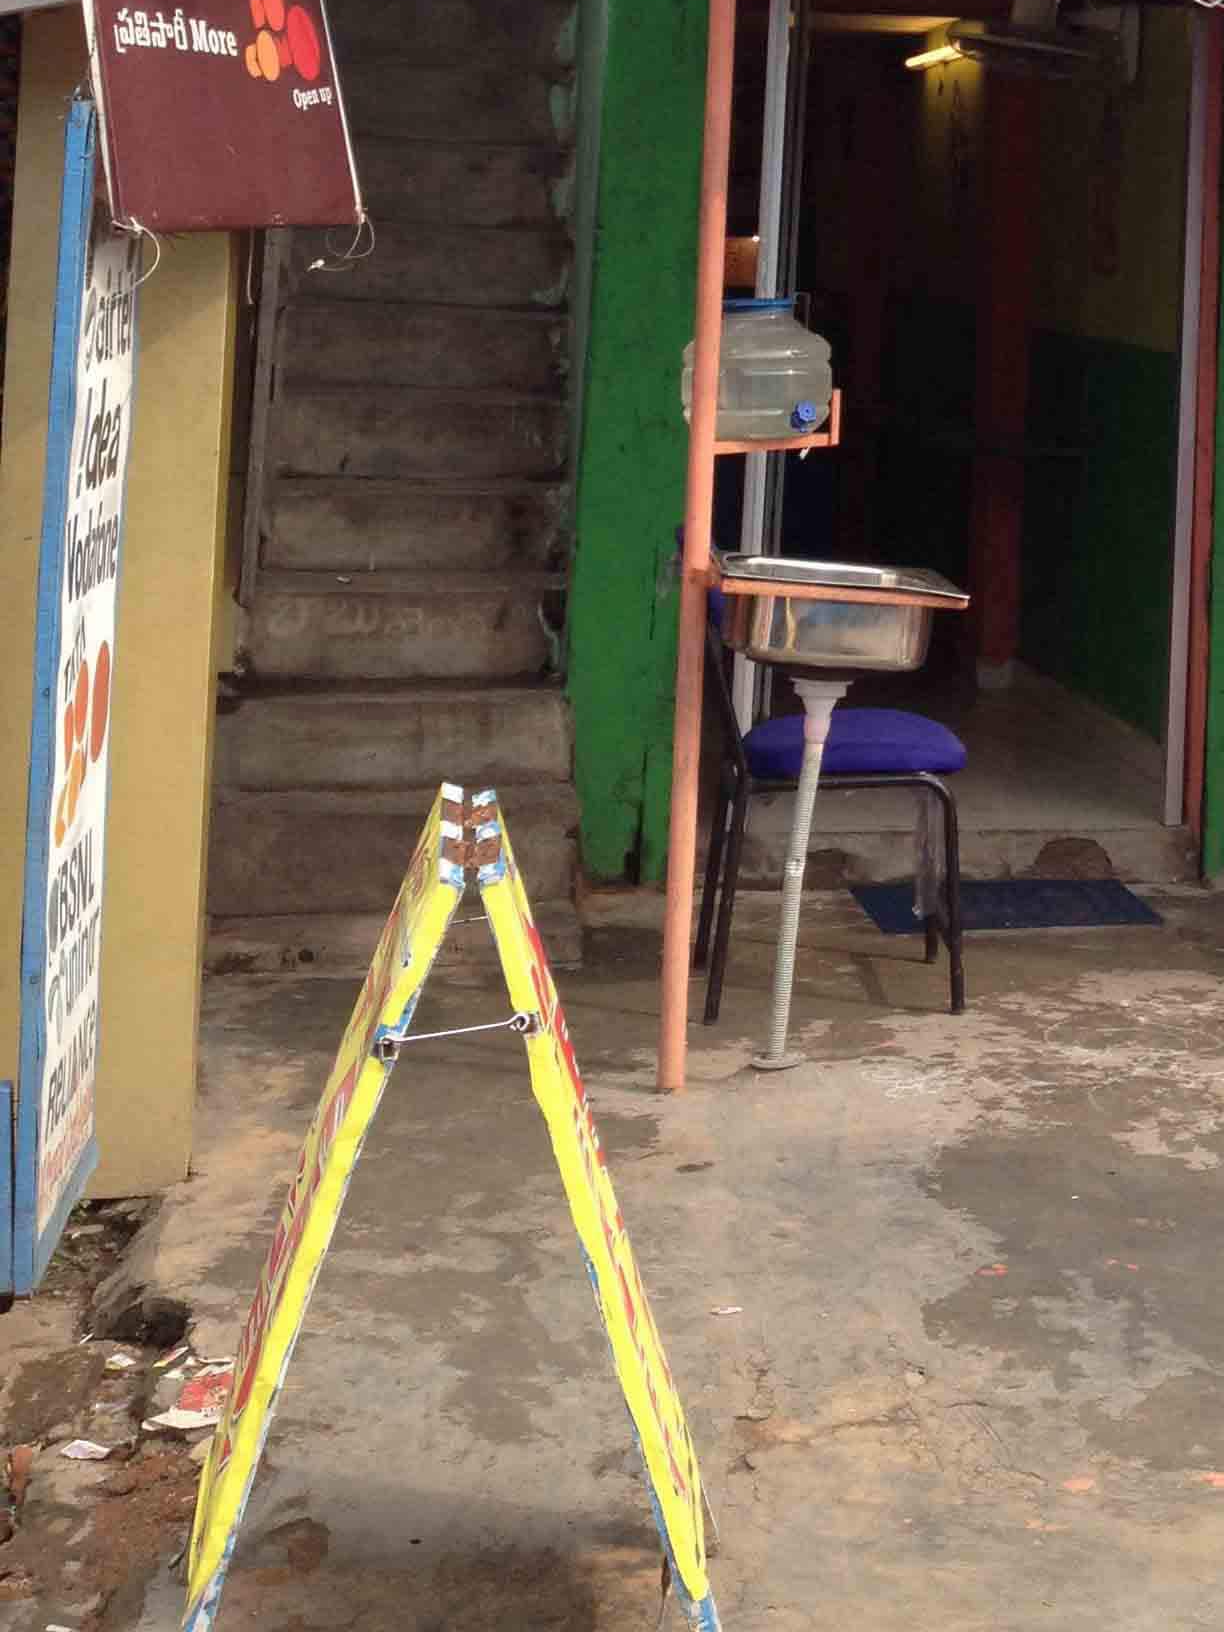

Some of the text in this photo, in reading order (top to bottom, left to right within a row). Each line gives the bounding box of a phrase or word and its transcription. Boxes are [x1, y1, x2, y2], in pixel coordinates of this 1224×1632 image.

[190, 18, 239, 57] More
[292, 86, 333, 110] Open up
[58, 828, 95, 944] BSNL
